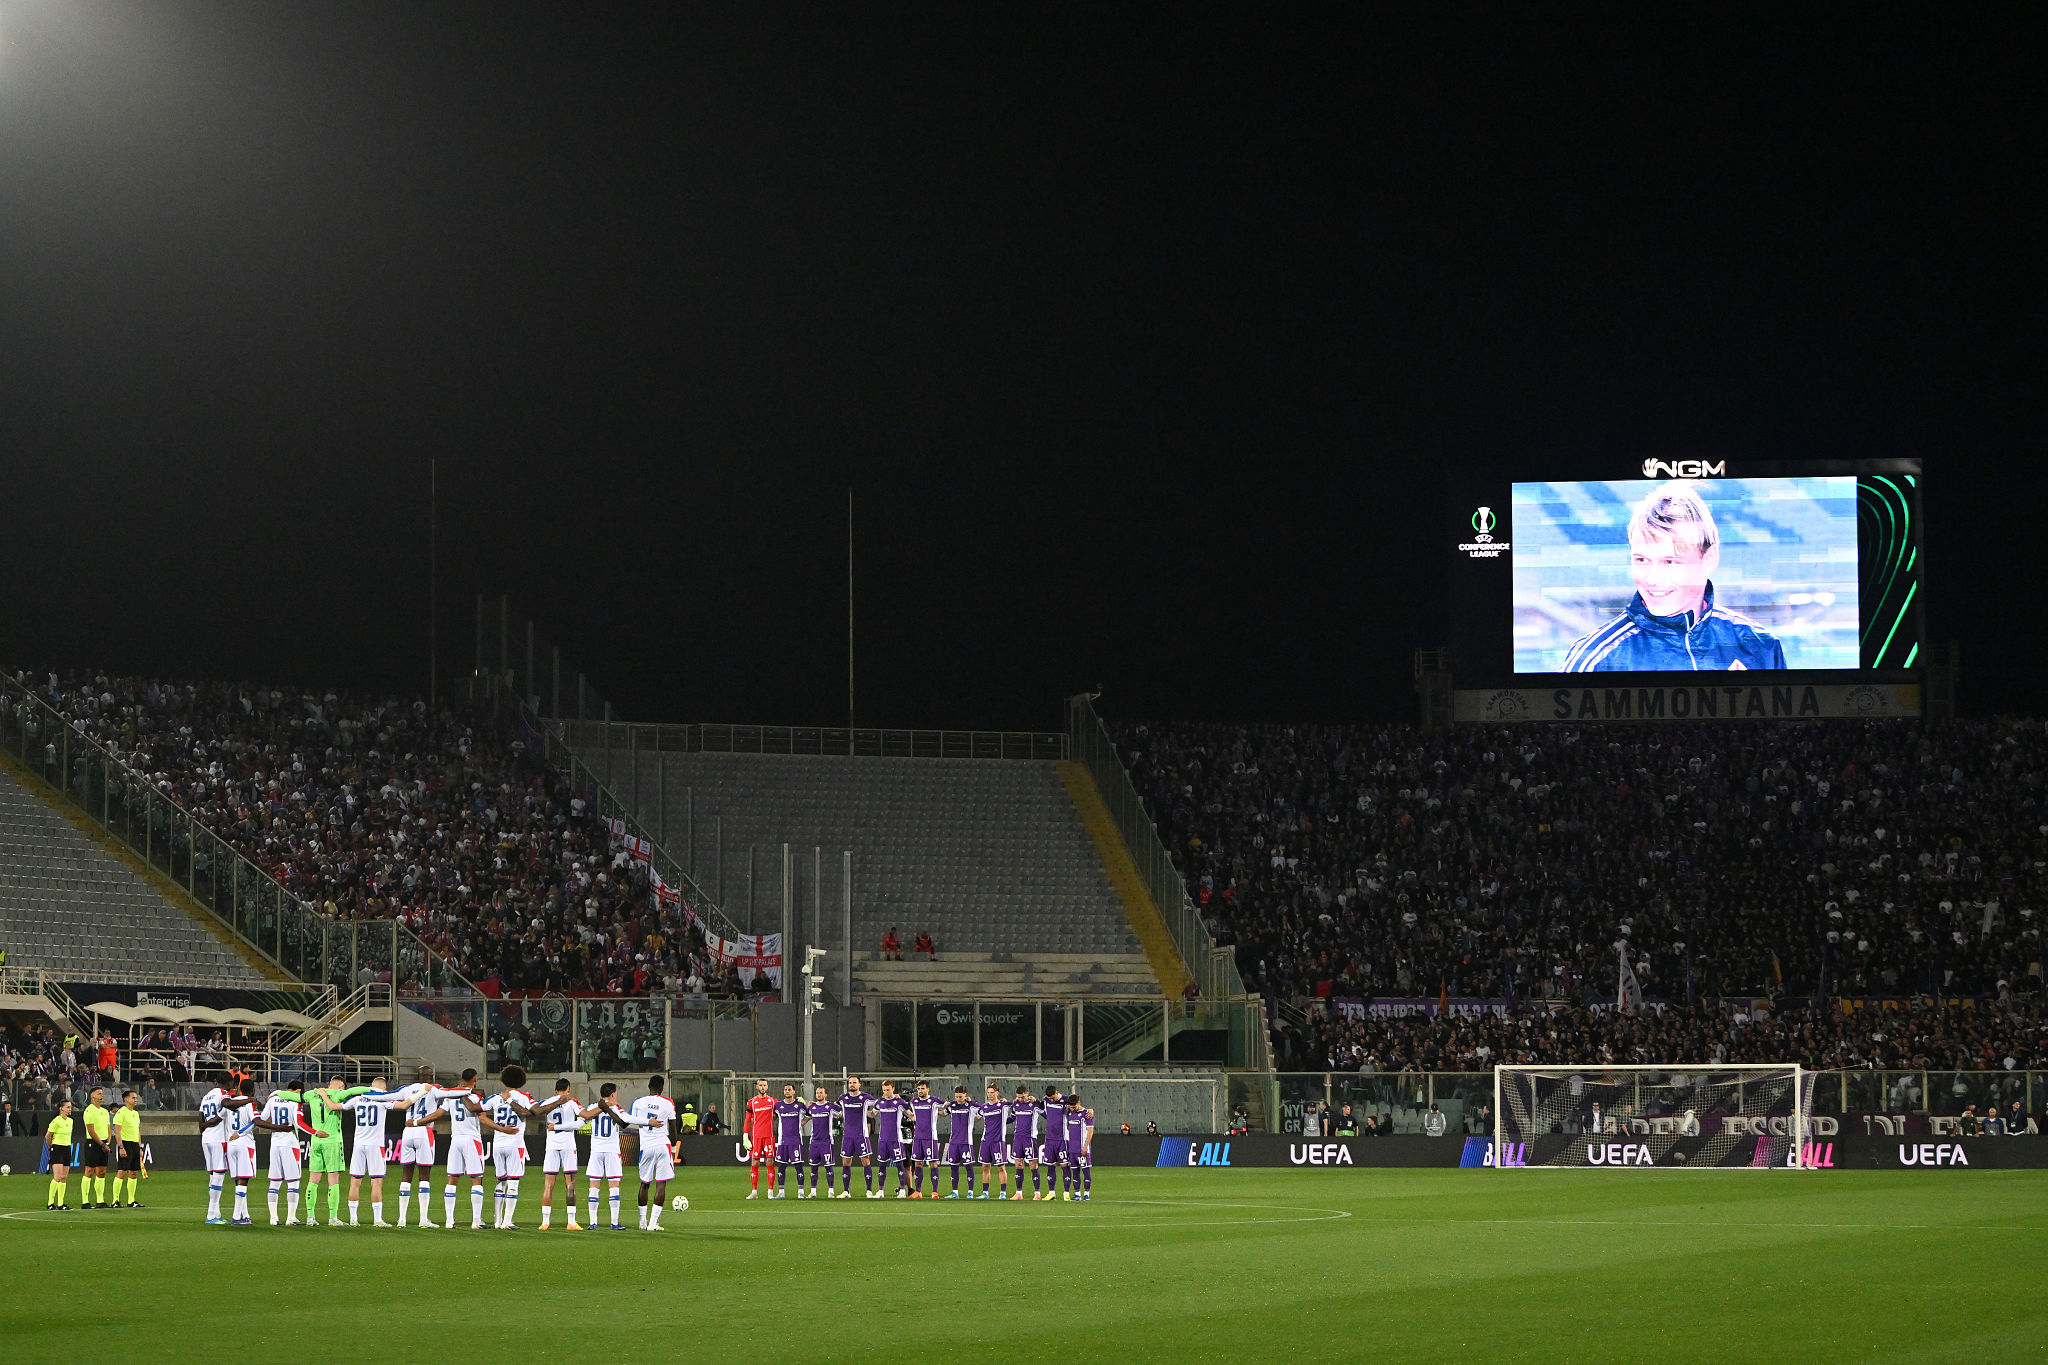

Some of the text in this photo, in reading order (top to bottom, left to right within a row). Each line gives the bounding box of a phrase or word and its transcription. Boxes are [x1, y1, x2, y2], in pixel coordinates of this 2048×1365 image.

[1655, 460, 1726, 478] NGM
[1458, 543, 1510, 551] CONFERENCE
[1469, 550, 1500, 558] LEAGUE
[1553, 686, 1820, 719] SAMMONTANA
[139, 994, 190, 1009] enterprise
[274, 1106, 289, 1125] 18
[319, 1103, 325, 1124] 1
[357, 1105, 378, 1126] 20
[411, 1097, 427, 1119] 14
[455, 1100, 466, 1122] 5
[232, 1109, 240, 1131] 3
[594, 1114, 612, 1138] 10
[1290, 1144, 1353, 1165] UEFA
[1588, 1144, 1654, 1165] UEFA
[1899, 1144, 1968, 1166] UEFA
